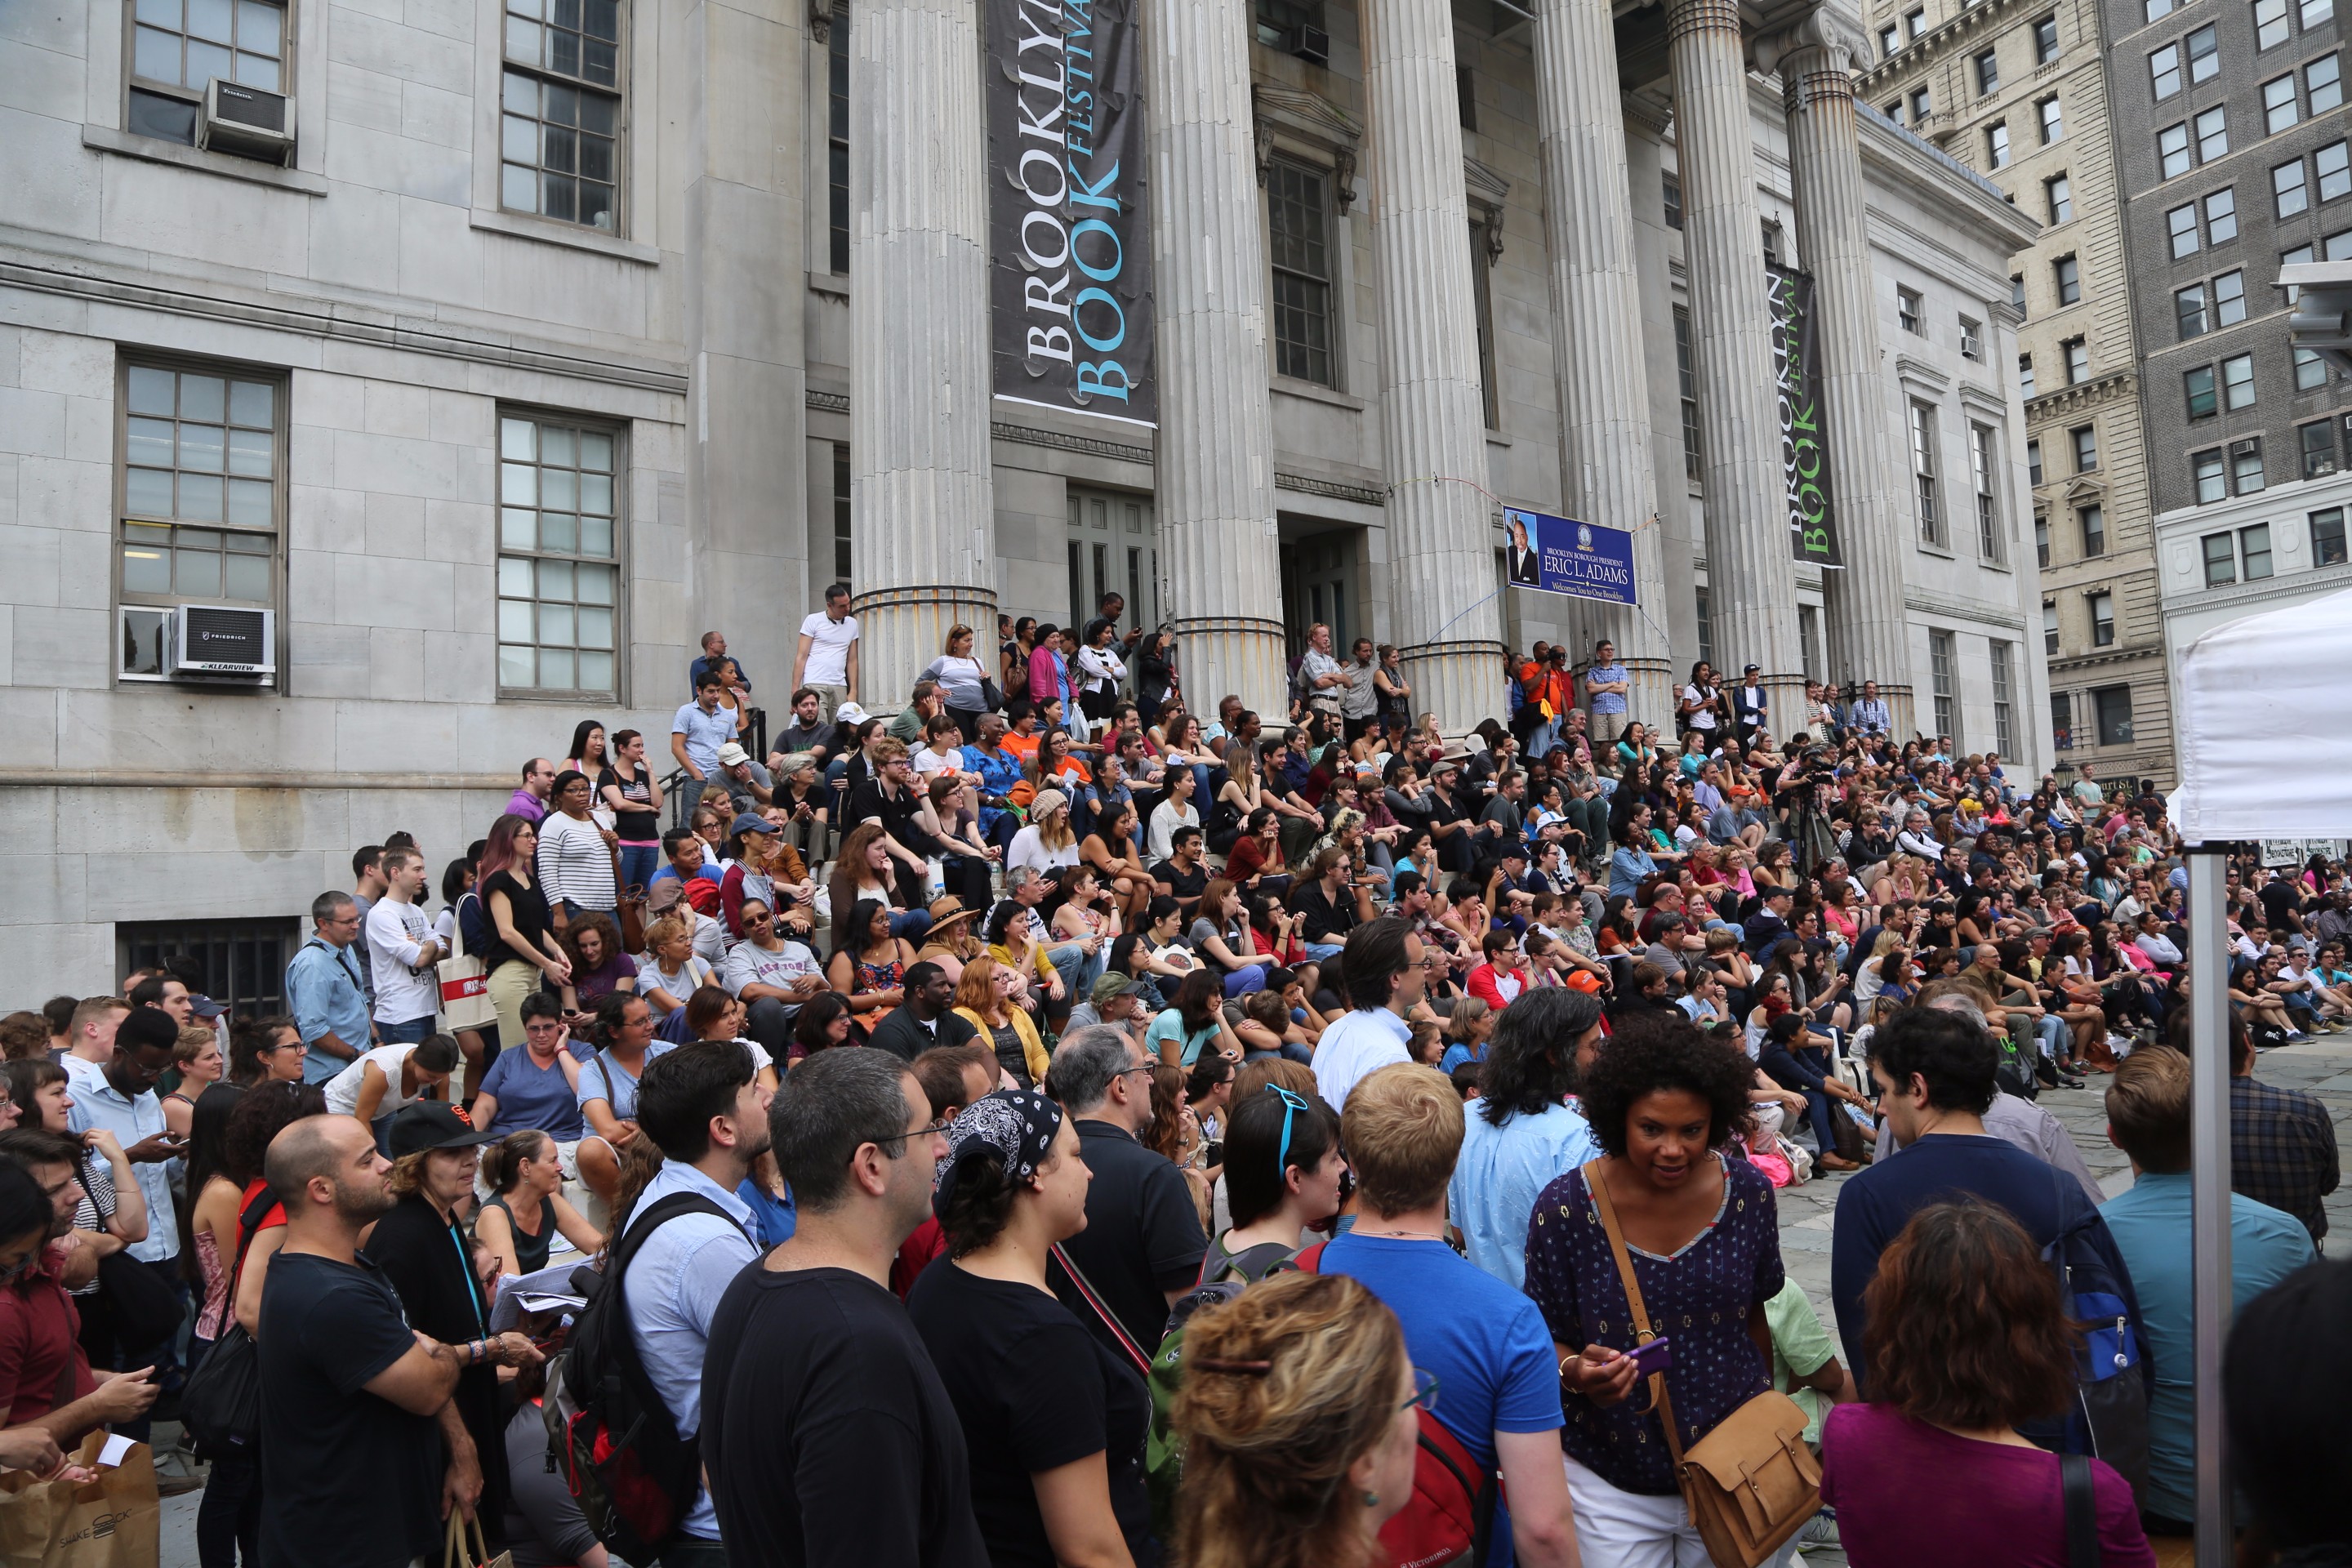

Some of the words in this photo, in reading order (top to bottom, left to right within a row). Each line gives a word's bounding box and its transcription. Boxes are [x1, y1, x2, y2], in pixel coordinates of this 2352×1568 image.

[224, 88, 252, 99] Friedrich
[1067, 158, 1128, 406] BOOK
[1783, 274, 1802, 399] FESTIVAL
[1792, 397, 1829, 556] BOOK
[1547, 547, 1573, 559] BROOKLYN
[1574, 551, 1598, 563] BOROUGH
[1598, 557, 1624, 568] PRESIDENT
[1544, 555, 1572, 576] ERIC
[1575, 561, 1584, 578] L.
[1587, 564, 1628, 585] ADAMS
[1552, 581, 1577, 593] Welcomes
[1576, 586, 1587, 595] You
[1586, 588, 1592, 596] to
[1592, 589, 1603, 598] One
[1603, 590, 1624, 602] Brooklyn
[207, 663, 255, 671] KLEARVIEW
[2119, 779, 2133, 789] St.
[2271, 849, 2295, 858] BOOKSTORE
[60, 1528, 91, 1548] SHAKE
[1408, 1547, 1452, 1568] VICTORINOX
